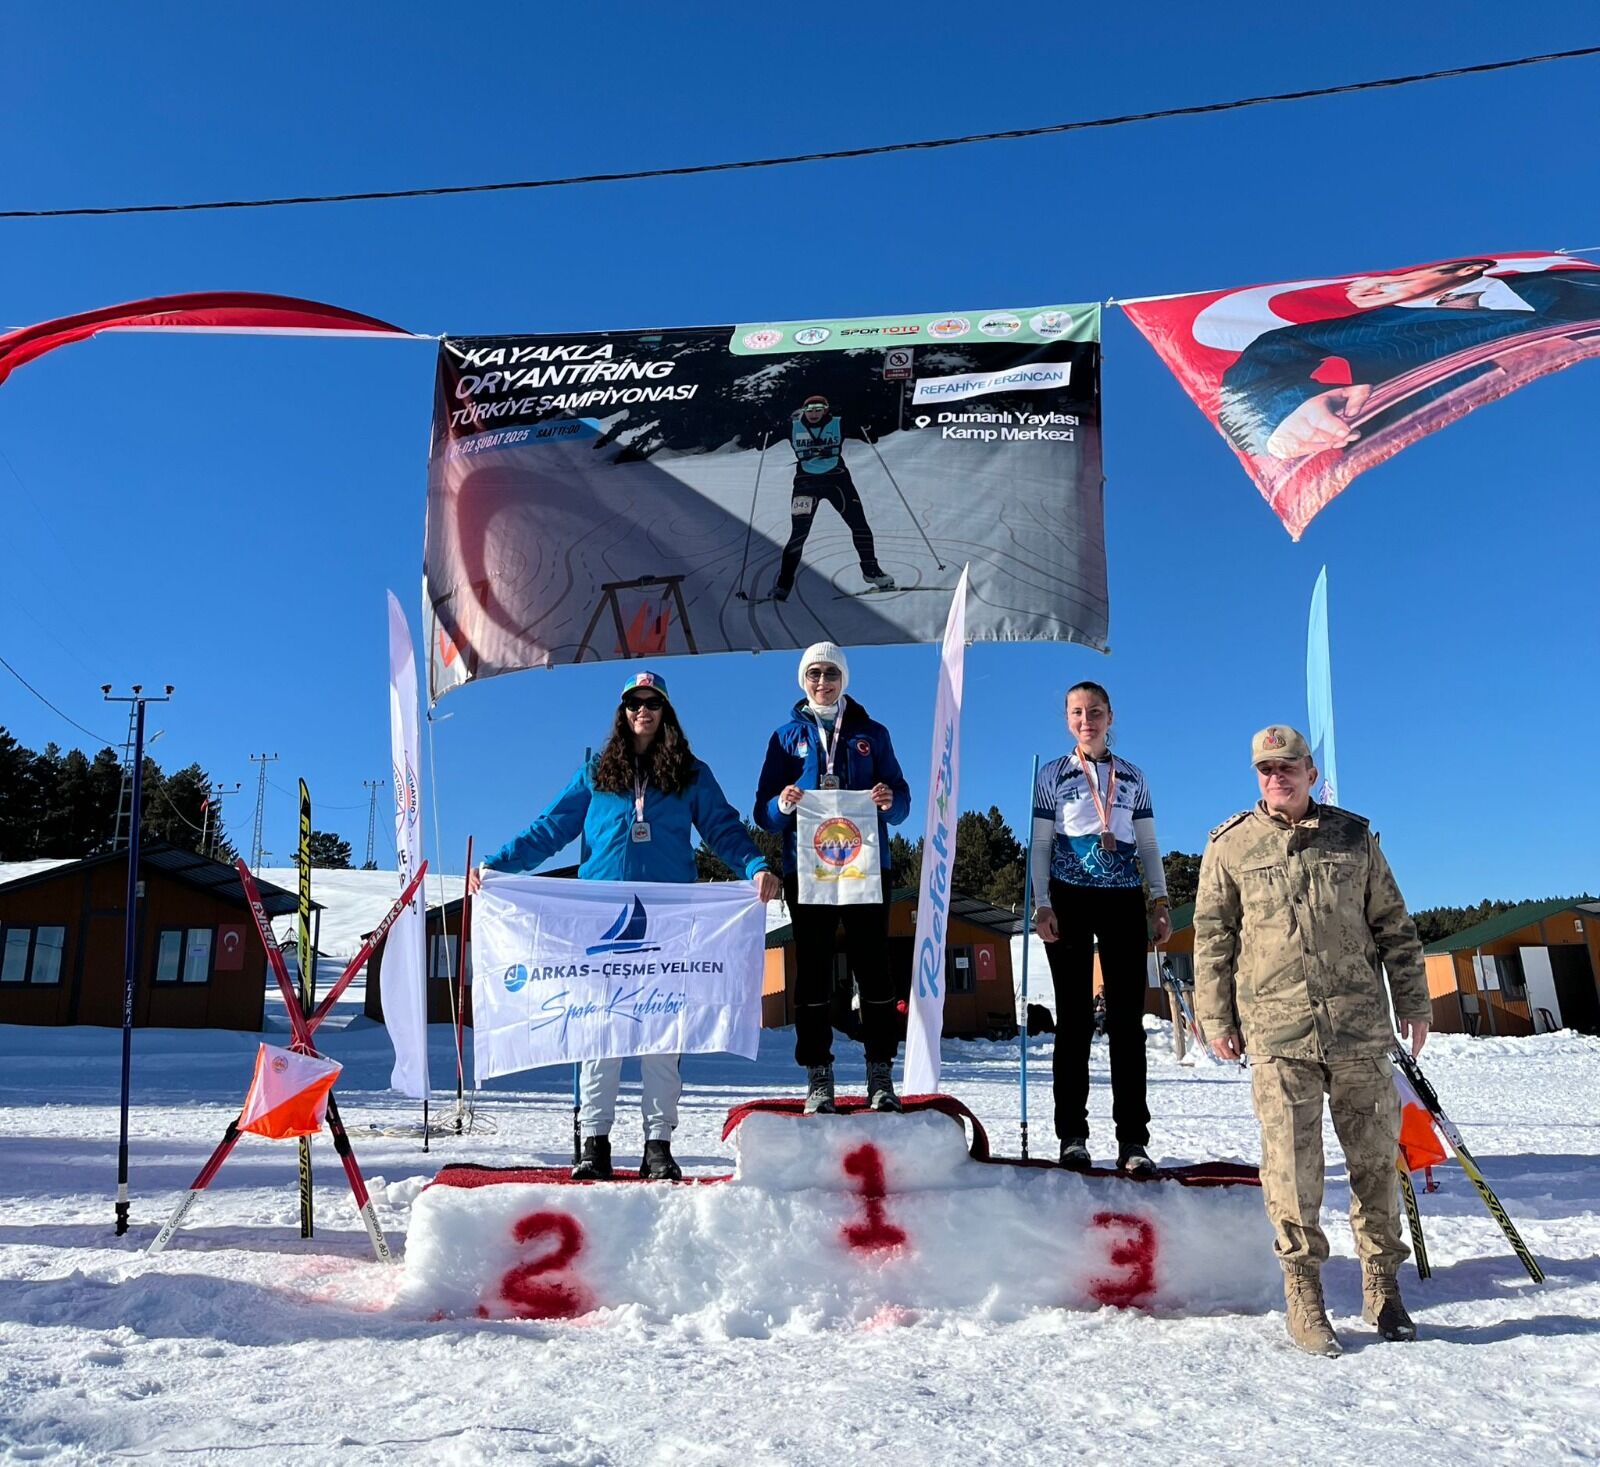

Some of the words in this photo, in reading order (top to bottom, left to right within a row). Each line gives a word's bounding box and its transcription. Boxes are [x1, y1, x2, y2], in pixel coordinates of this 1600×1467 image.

[460, 343, 614, 369] KAYAKLA
[455, 359, 676, 399] ORYANTİRİNG
[920, 378, 986, 396] REFAHİYE
[994, 370, 1064, 386] ERZİNCAN
[450, 396, 541, 428] TÜRKİYE
[536, 384, 699, 417] ŞAMPİYONASI
[937, 411, 1012, 426] Dumanlı
[1014, 411, 1079, 428] Yaylası
[474, 436, 505, 455] ŞUBAT
[503, 430, 530, 444] 2025
[942, 426, 998, 443] Kamp
[1001, 427, 1075, 442] Merkezi
[661, 961, 724, 974] YELKEN
[840, 1141, 907, 1250] 1
[498, 1210, 586, 1319] 2
[1089, 1210, 1160, 1309] 3
